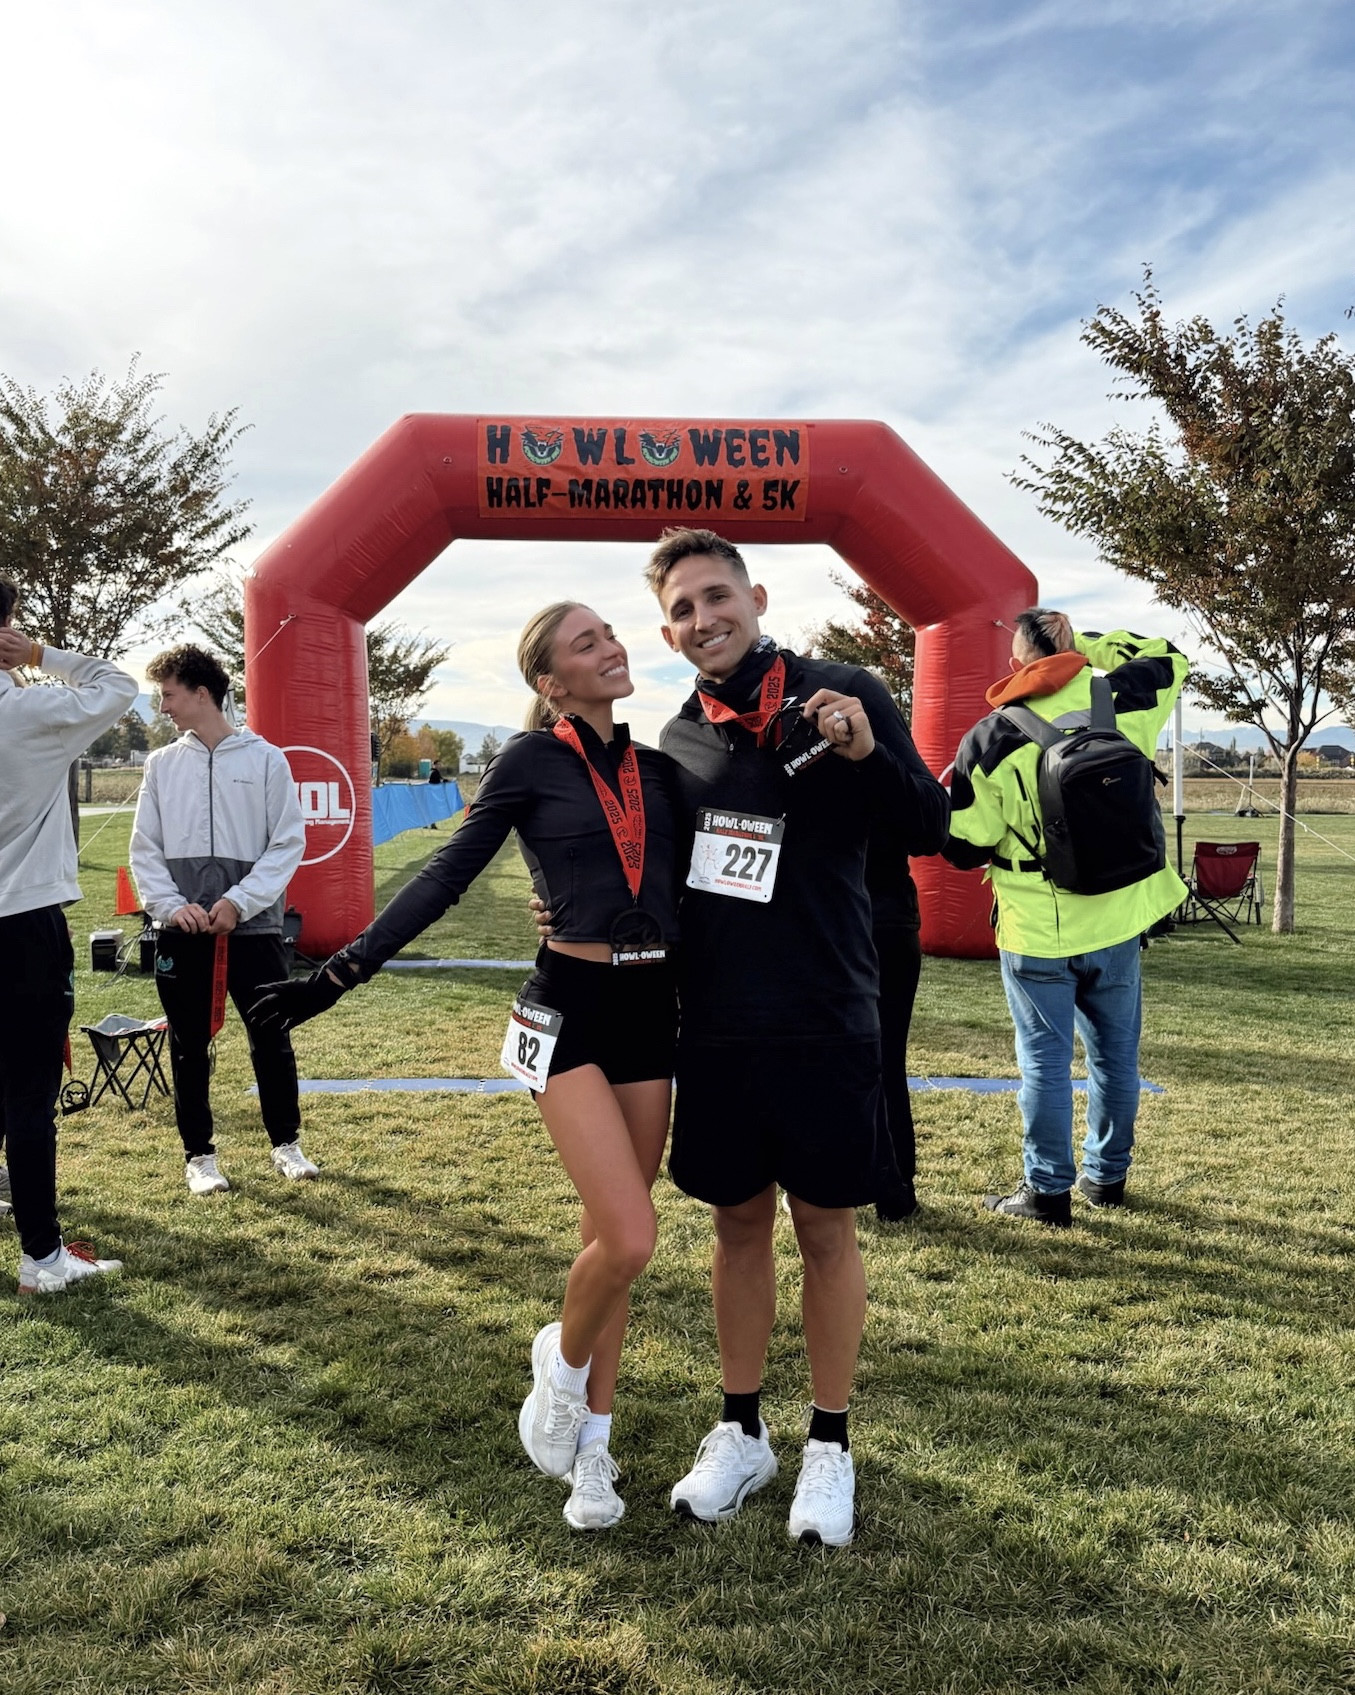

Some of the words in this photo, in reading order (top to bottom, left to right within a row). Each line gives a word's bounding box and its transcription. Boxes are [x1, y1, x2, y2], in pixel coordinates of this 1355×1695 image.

[486, 476, 724, 511] HALF-MARATHON
[733, 479, 752, 511] &
[762, 479, 801, 511] 5K
[767, 676, 780, 700] 2025
[790, 738, 831, 769] HOWL-OWEE
[293, 782, 351, 819] OL
[604, 800, 622, 825] 2025
[626, 788, 640, 813] 2025
[703, 812, 712, 832] 2025
[711, 814, 774, 835] HOWL-OWEEN
[721, 843, 773, 883] 227
[518, 1031, 541, 1072] 82
